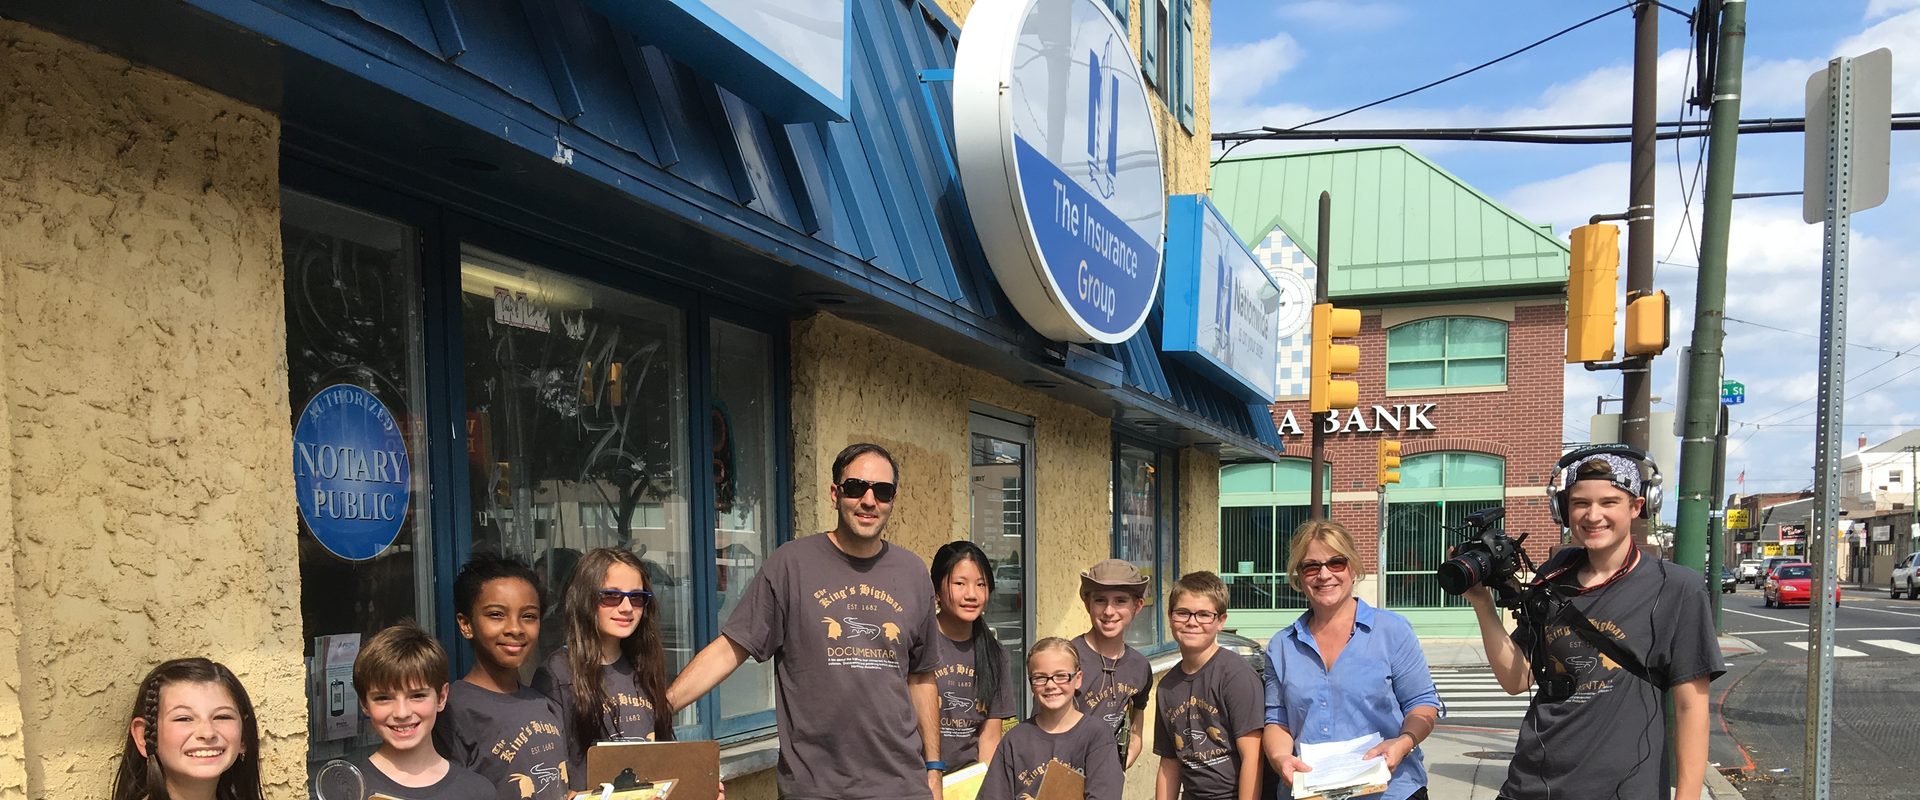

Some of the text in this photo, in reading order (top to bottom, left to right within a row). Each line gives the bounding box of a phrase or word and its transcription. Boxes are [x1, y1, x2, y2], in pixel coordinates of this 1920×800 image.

[1053, 178, 1138, 280] The Insurance
[1077, 259, 1117, 323] Group
[1233, 275, 1269, 341] Nationwide
[308, 389, 393, 431] AUTHORIZED
[1732, 386, 1743, 395] St
[1323, 402, 1437, 435] BANK
[297, 442, 406, 484] NOTARY
[313, 488, 396, 521] PUBLIC
[819, 583, 904, 613] King's Highway
[500, 725, 533, 763] King's
